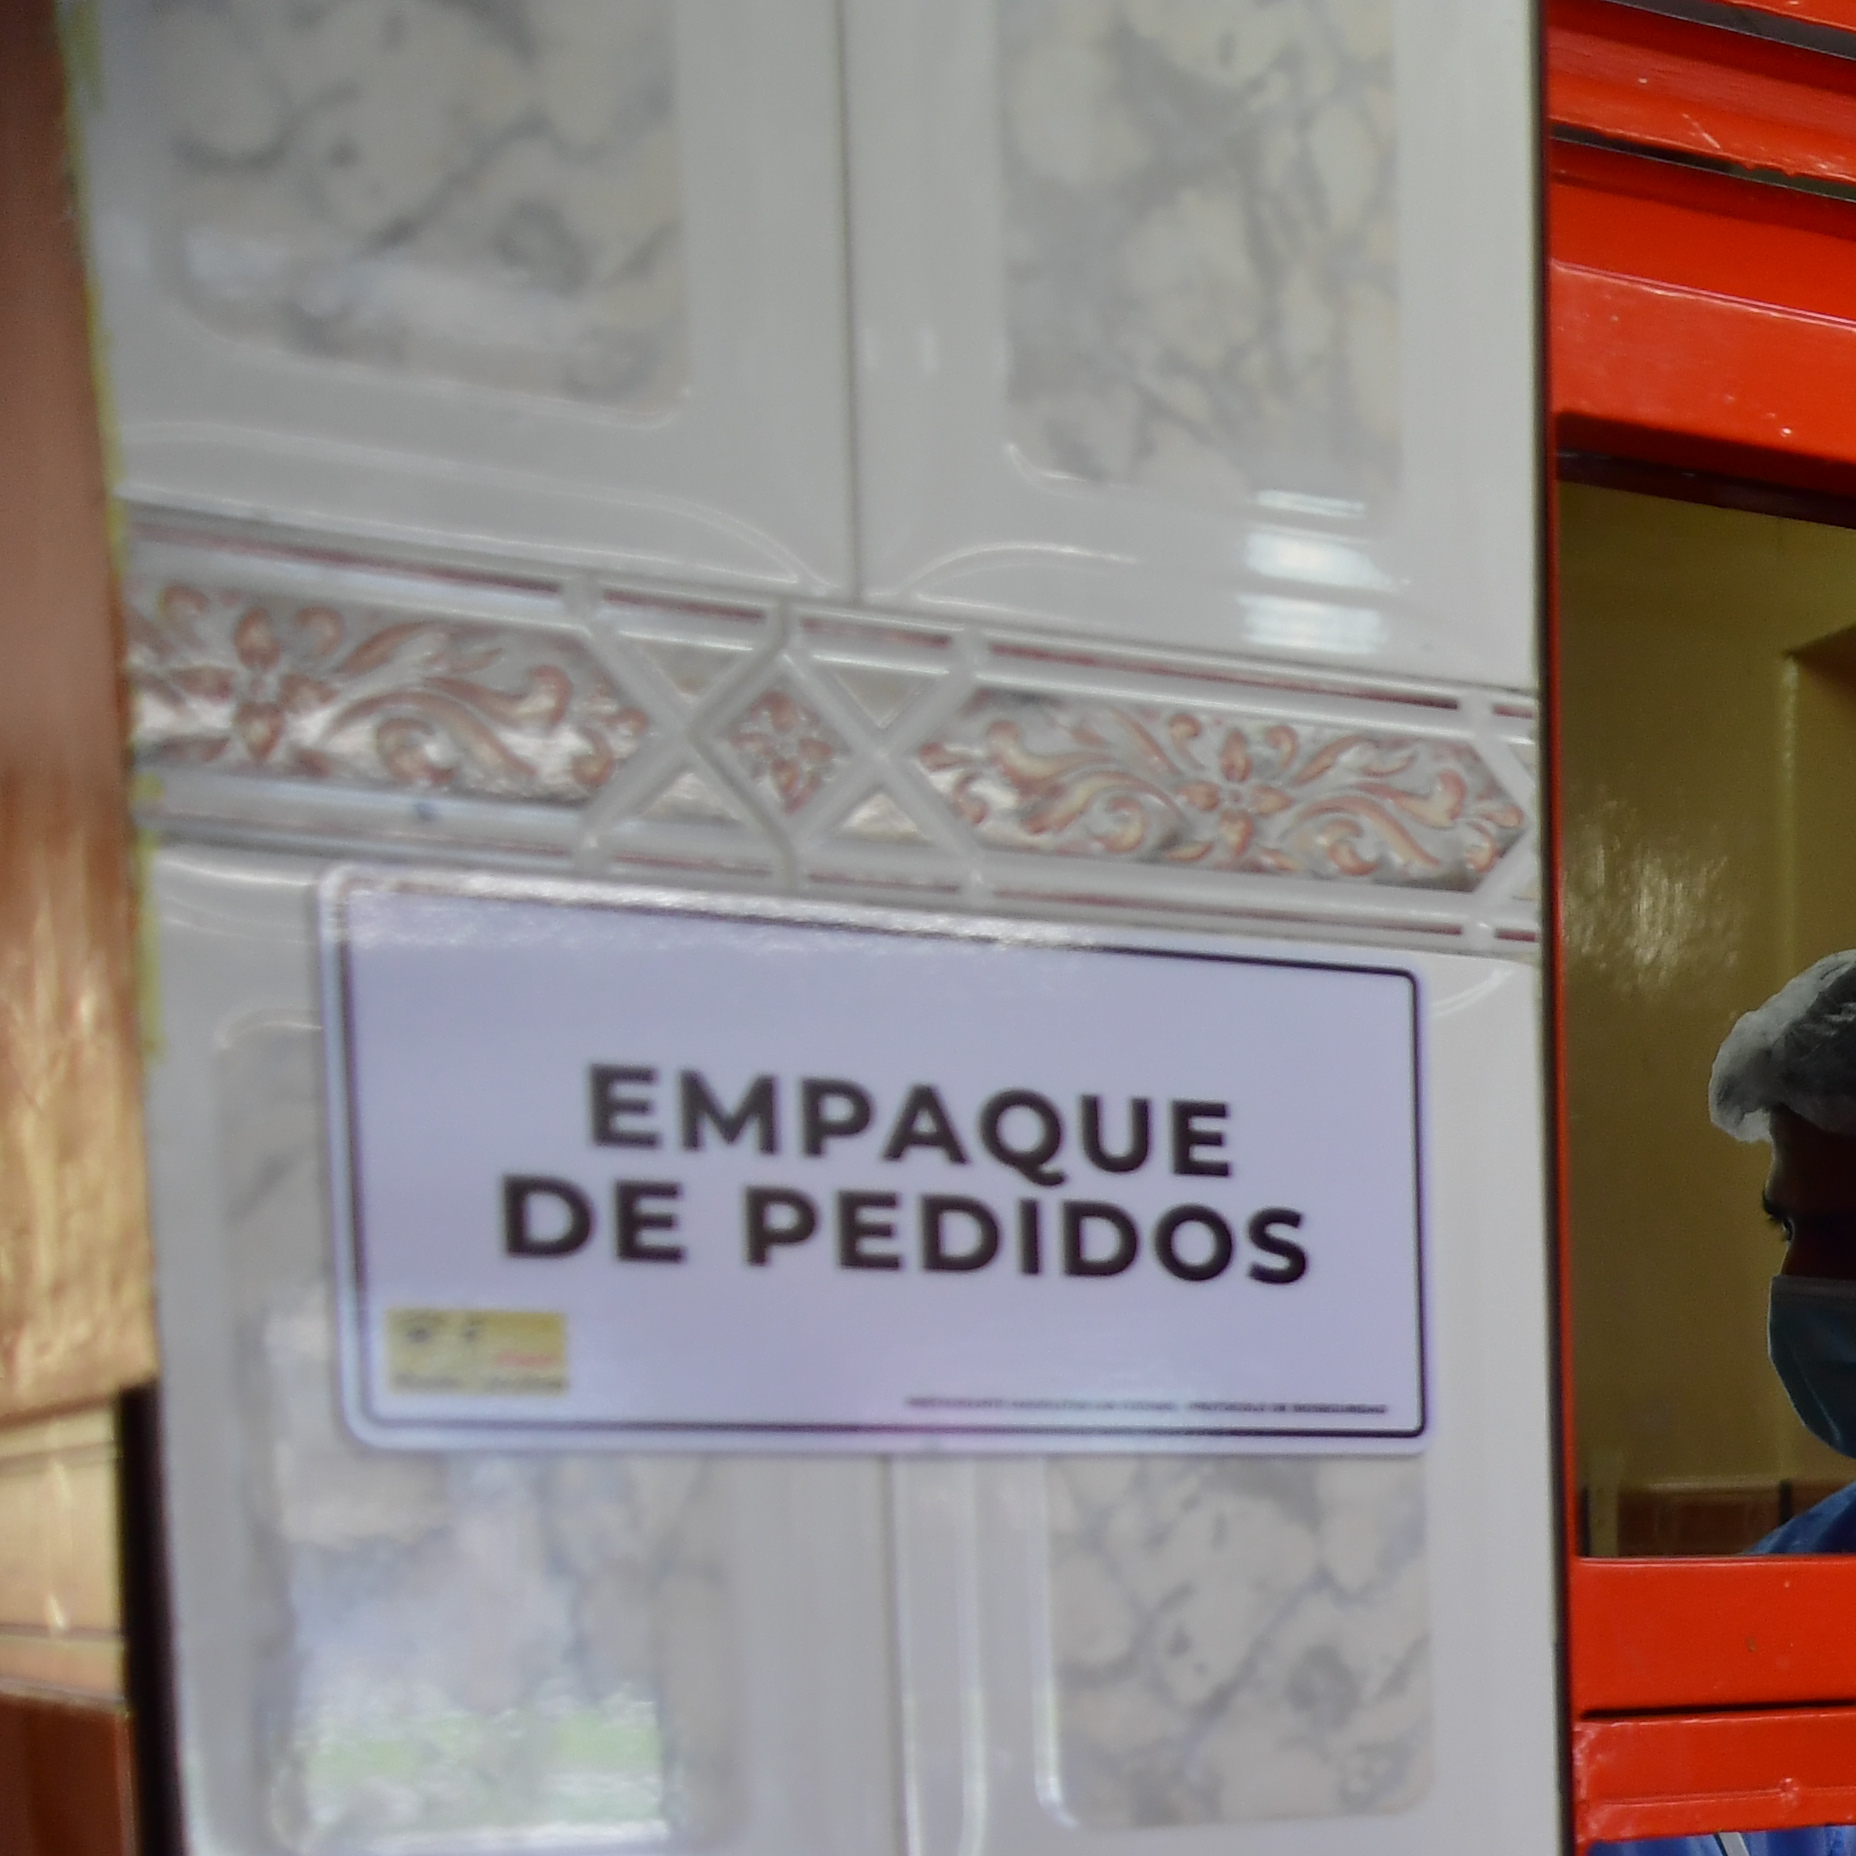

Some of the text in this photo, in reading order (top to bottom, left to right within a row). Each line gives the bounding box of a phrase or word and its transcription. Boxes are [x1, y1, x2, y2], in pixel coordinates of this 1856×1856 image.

[588, 1064, 1235, 1190] EMPAQUE
[500, 1173, 1310, 1287] DE PEDIDOS
